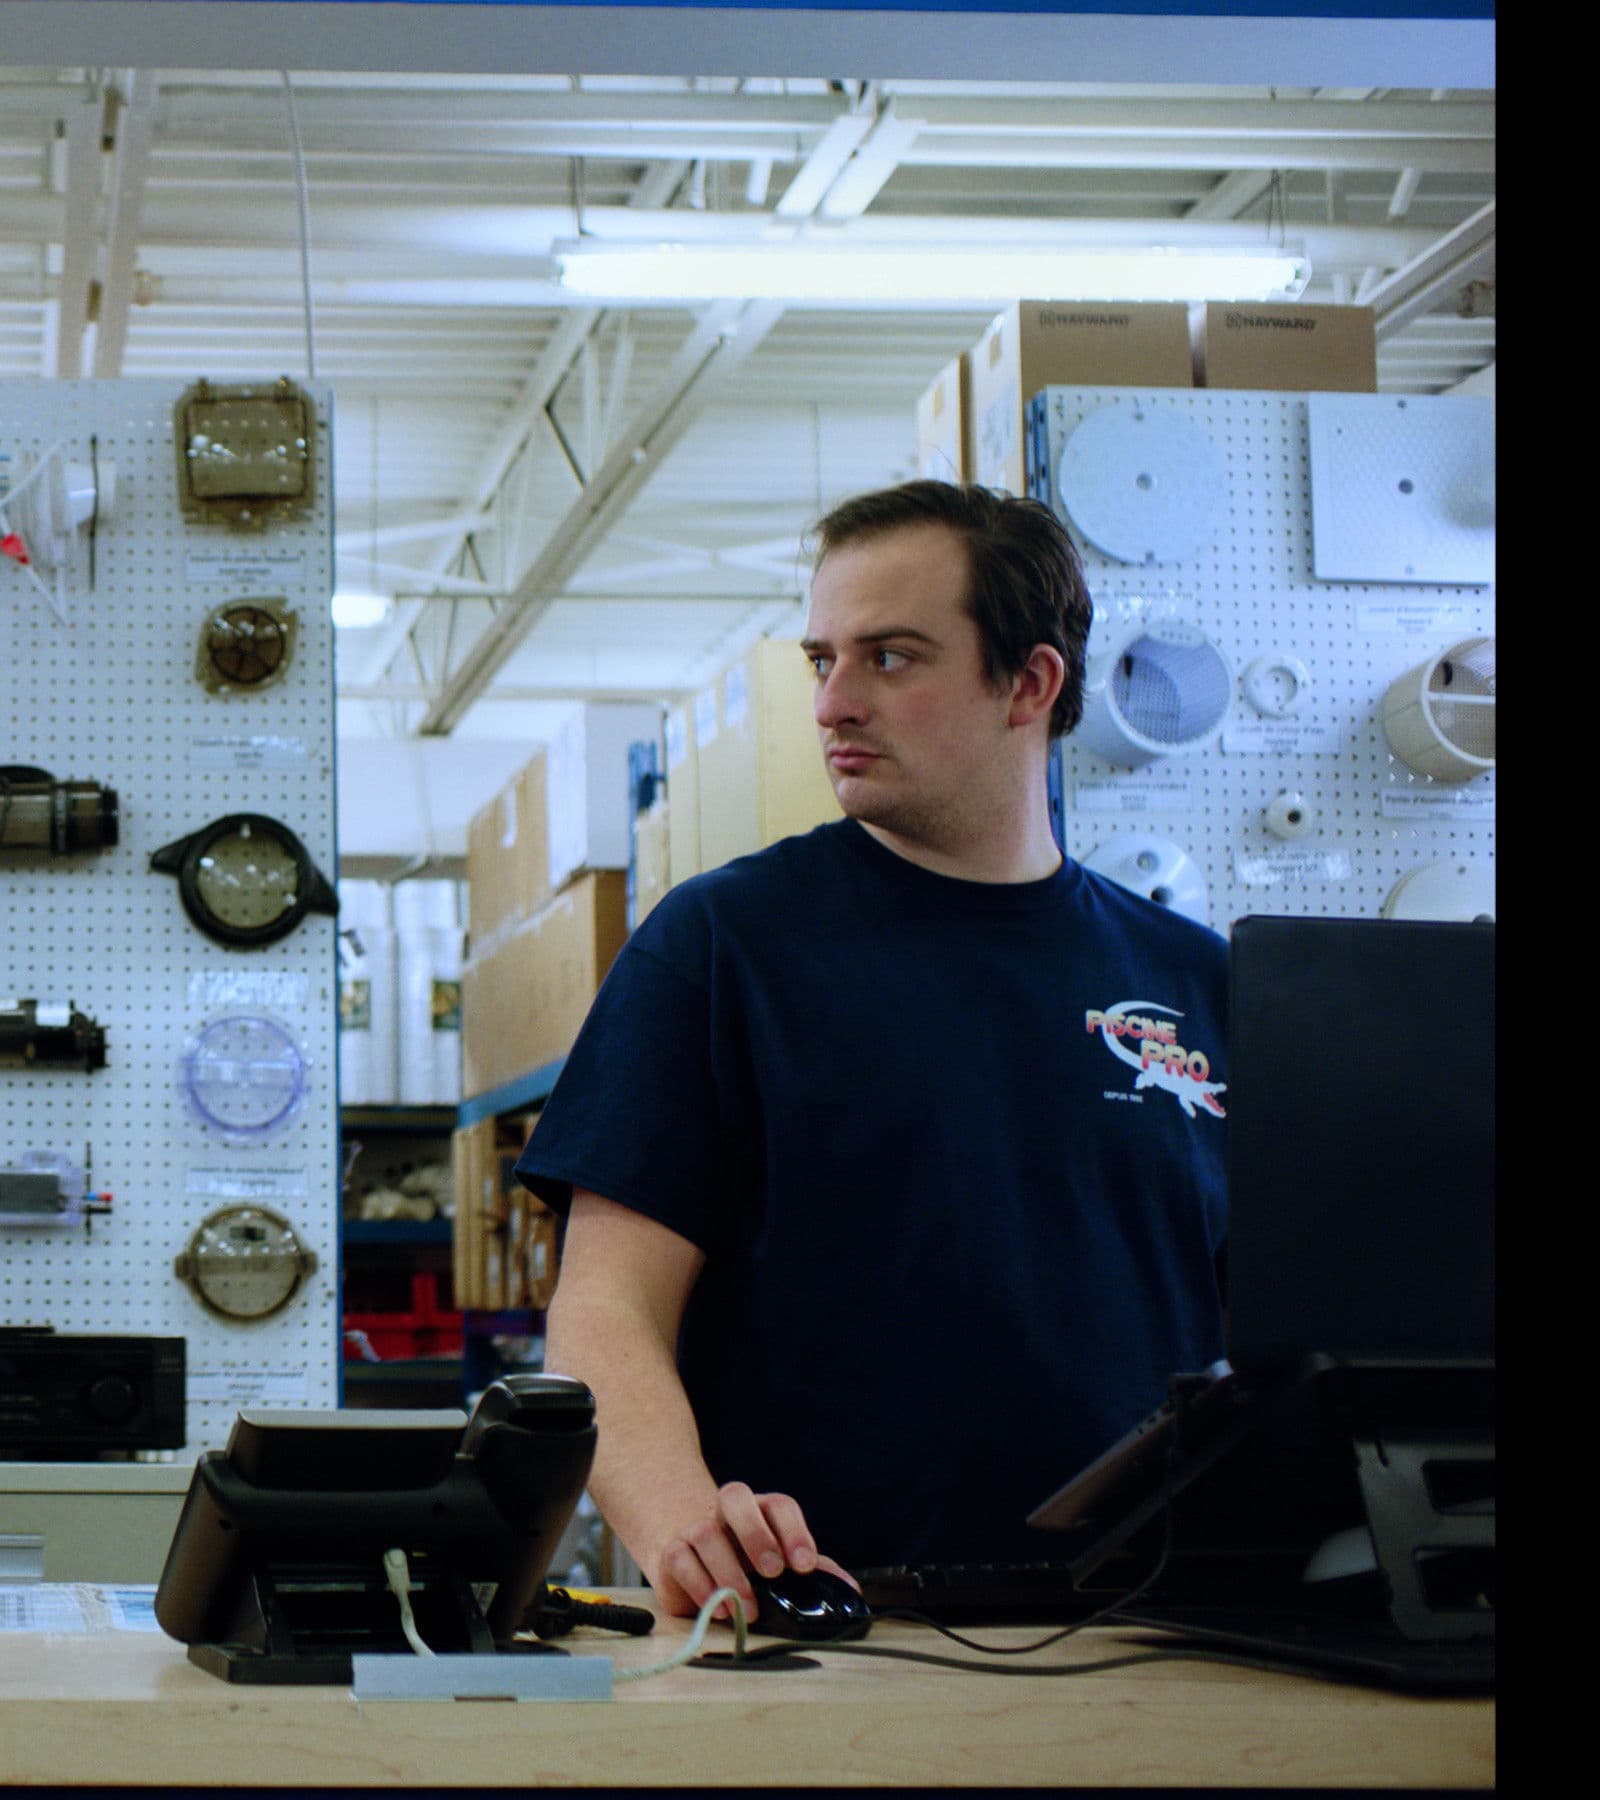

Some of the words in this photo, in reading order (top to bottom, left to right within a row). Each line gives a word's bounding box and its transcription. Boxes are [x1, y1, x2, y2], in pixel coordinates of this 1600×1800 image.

[1056, 313, 1131, 327] HAYWARD
[1242, 315, 1317, 331] HAYWARD
[1085, 1008, 1177, 1045] PISCINE
[1140, 1039, 1211, 1083] PRO
